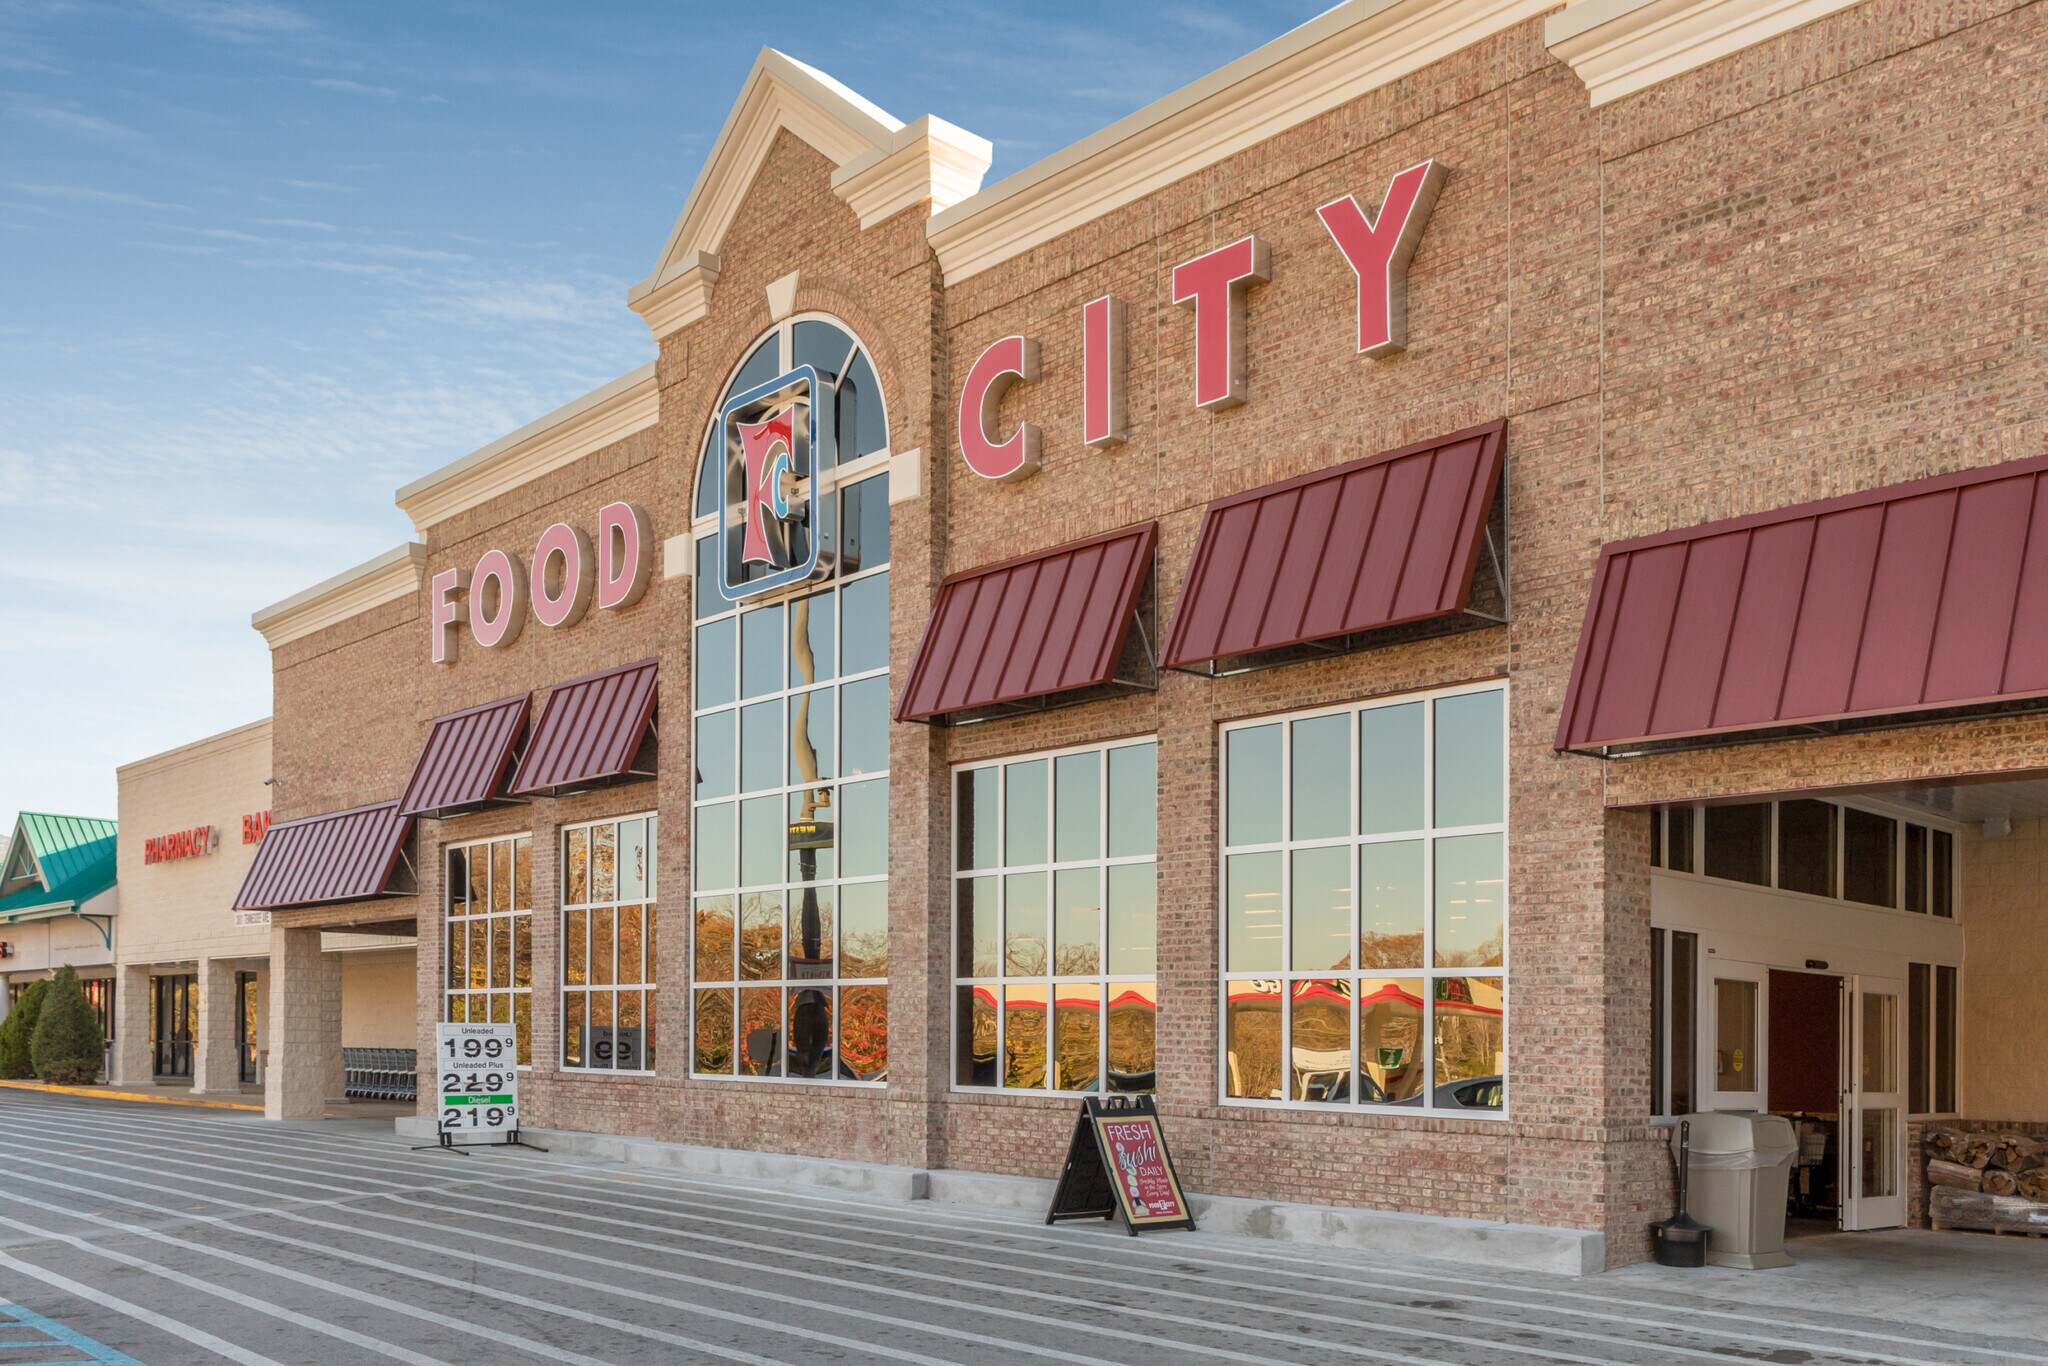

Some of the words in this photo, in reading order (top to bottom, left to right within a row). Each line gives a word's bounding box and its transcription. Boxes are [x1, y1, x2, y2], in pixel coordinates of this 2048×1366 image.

[432, 501, 648, 664] FOOD
[958, 158, 1444, 482] CITY
[144, 825, 211, 865] PHARMACY
[461, 1027, 494, 1035] Unleaded
[488, 1061, 504, 1069] Plus
[468, 1096, 491, 1104] Diesel
[1107, 1124, 1151, 1141] FRESH
[1139, 1166, 1163, 1177] DAILY
